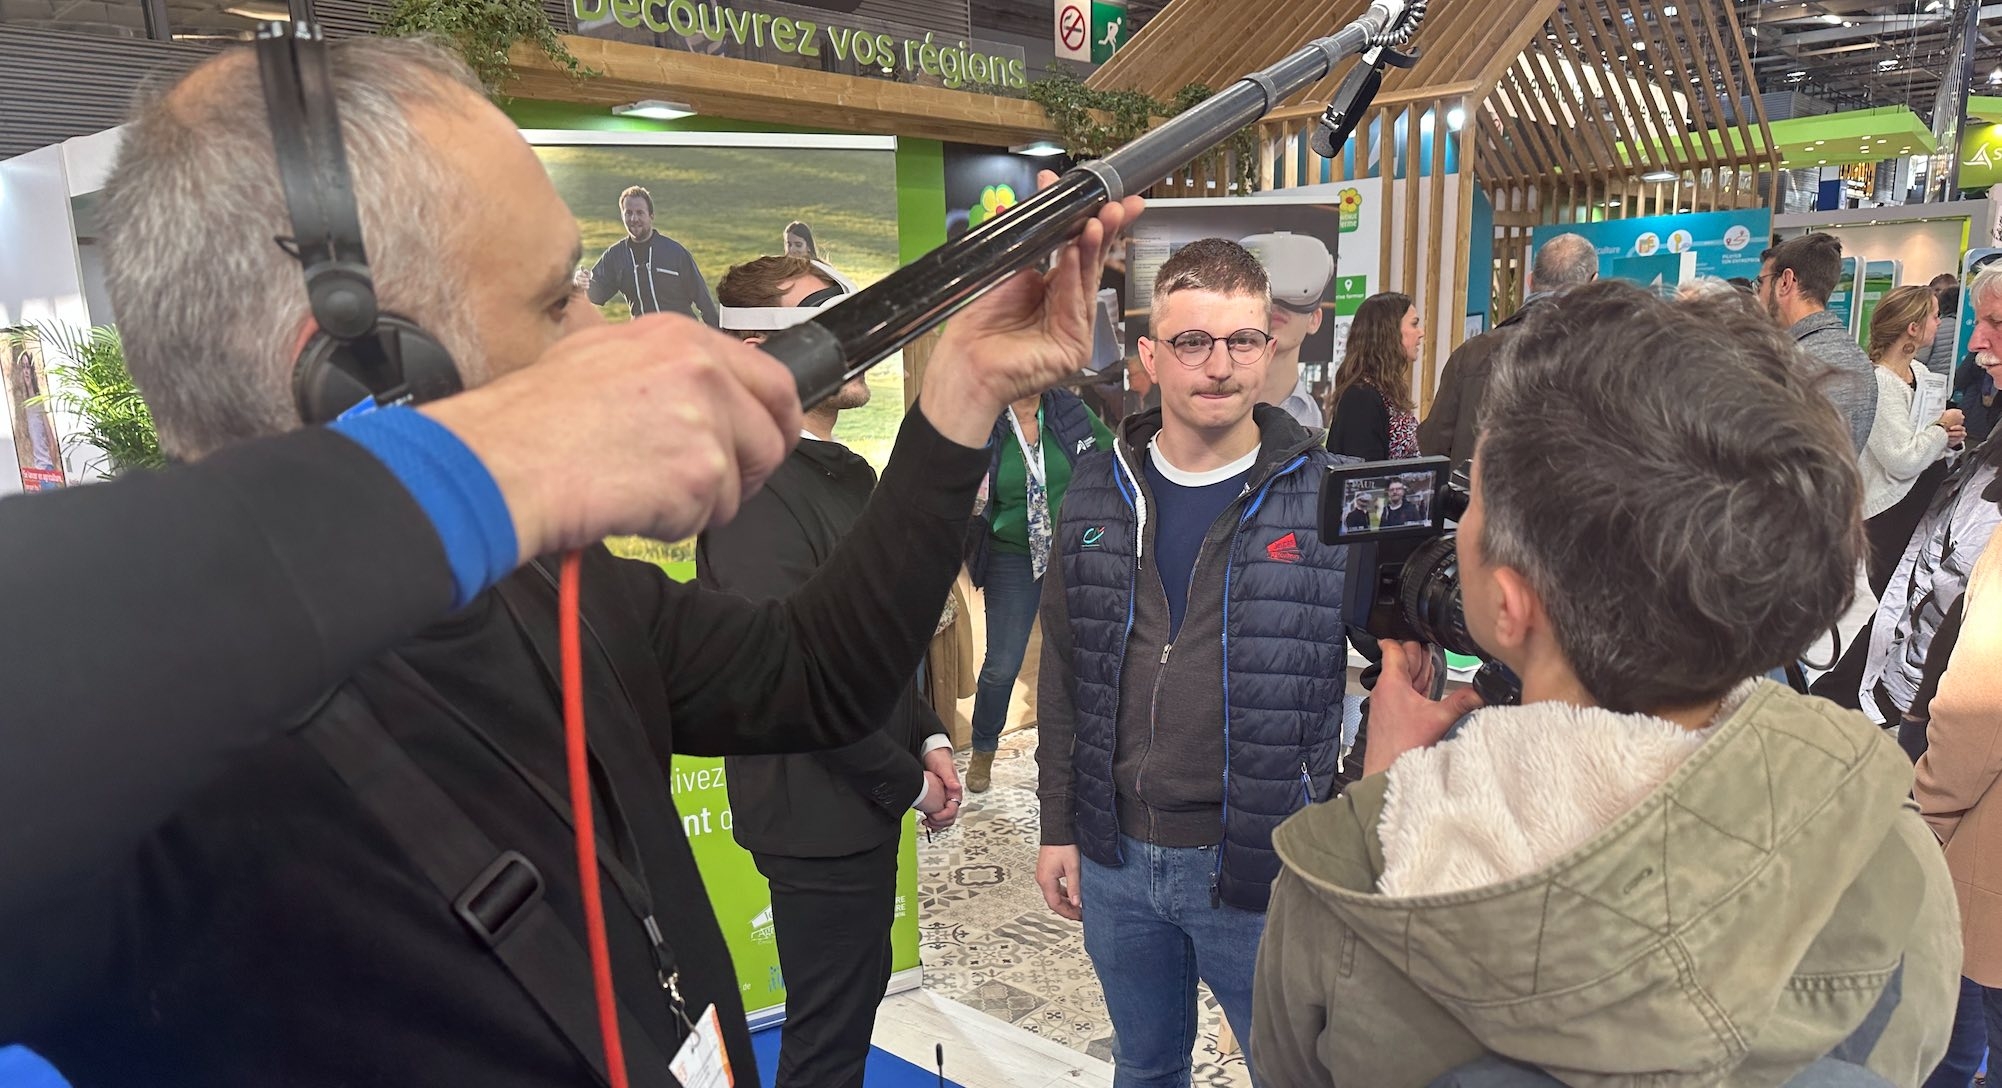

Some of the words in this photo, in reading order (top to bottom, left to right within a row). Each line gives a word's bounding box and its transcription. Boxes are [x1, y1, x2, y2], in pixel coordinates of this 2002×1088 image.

[828, 25, 896, 68] vos
[904, 31, 1027, 89] régions
[671, 767, 725, 795] ivez
